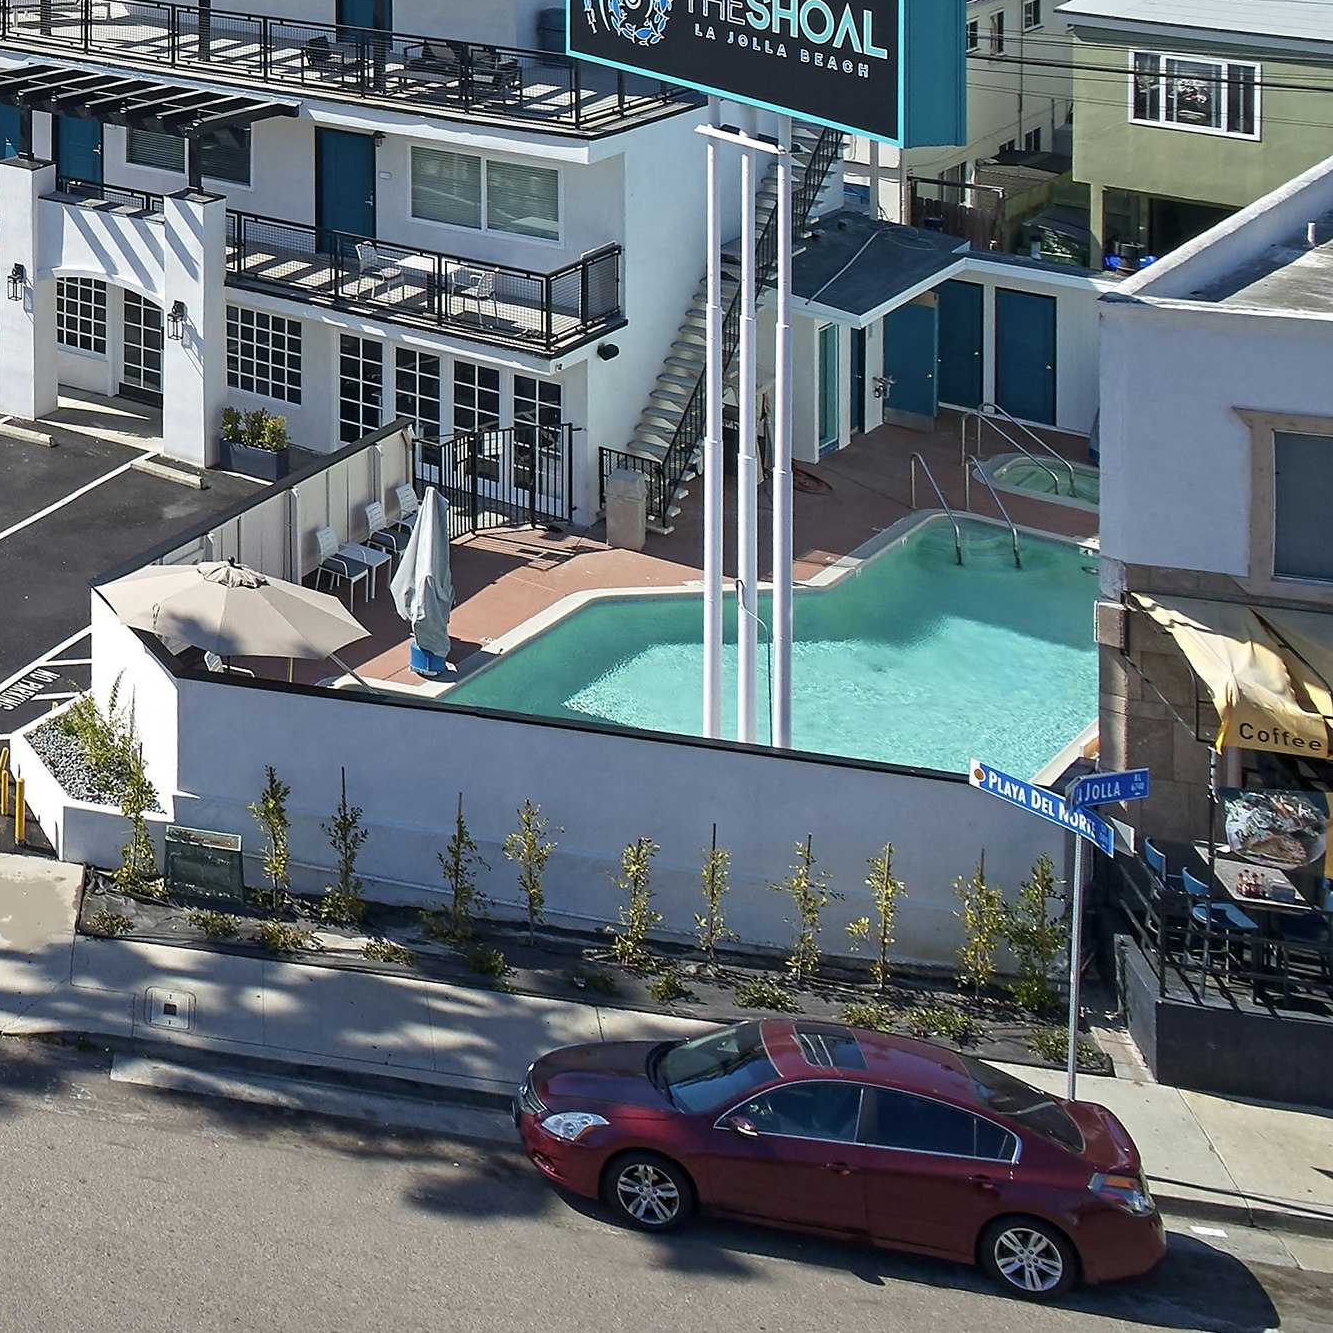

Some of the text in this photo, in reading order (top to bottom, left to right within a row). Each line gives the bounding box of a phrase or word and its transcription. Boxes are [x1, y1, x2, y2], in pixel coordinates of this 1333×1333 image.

[694, 23, 869, 78] LA JOLLA BEACH
[29, 668, 61, 683] NO
[1239, 722, 1322, 751] Coffee
[988, 771, 1027, 805] PLAYA
[1031, 789, 1056, 817] DEL
[1084, 781, 1121, 802] JOLLA
